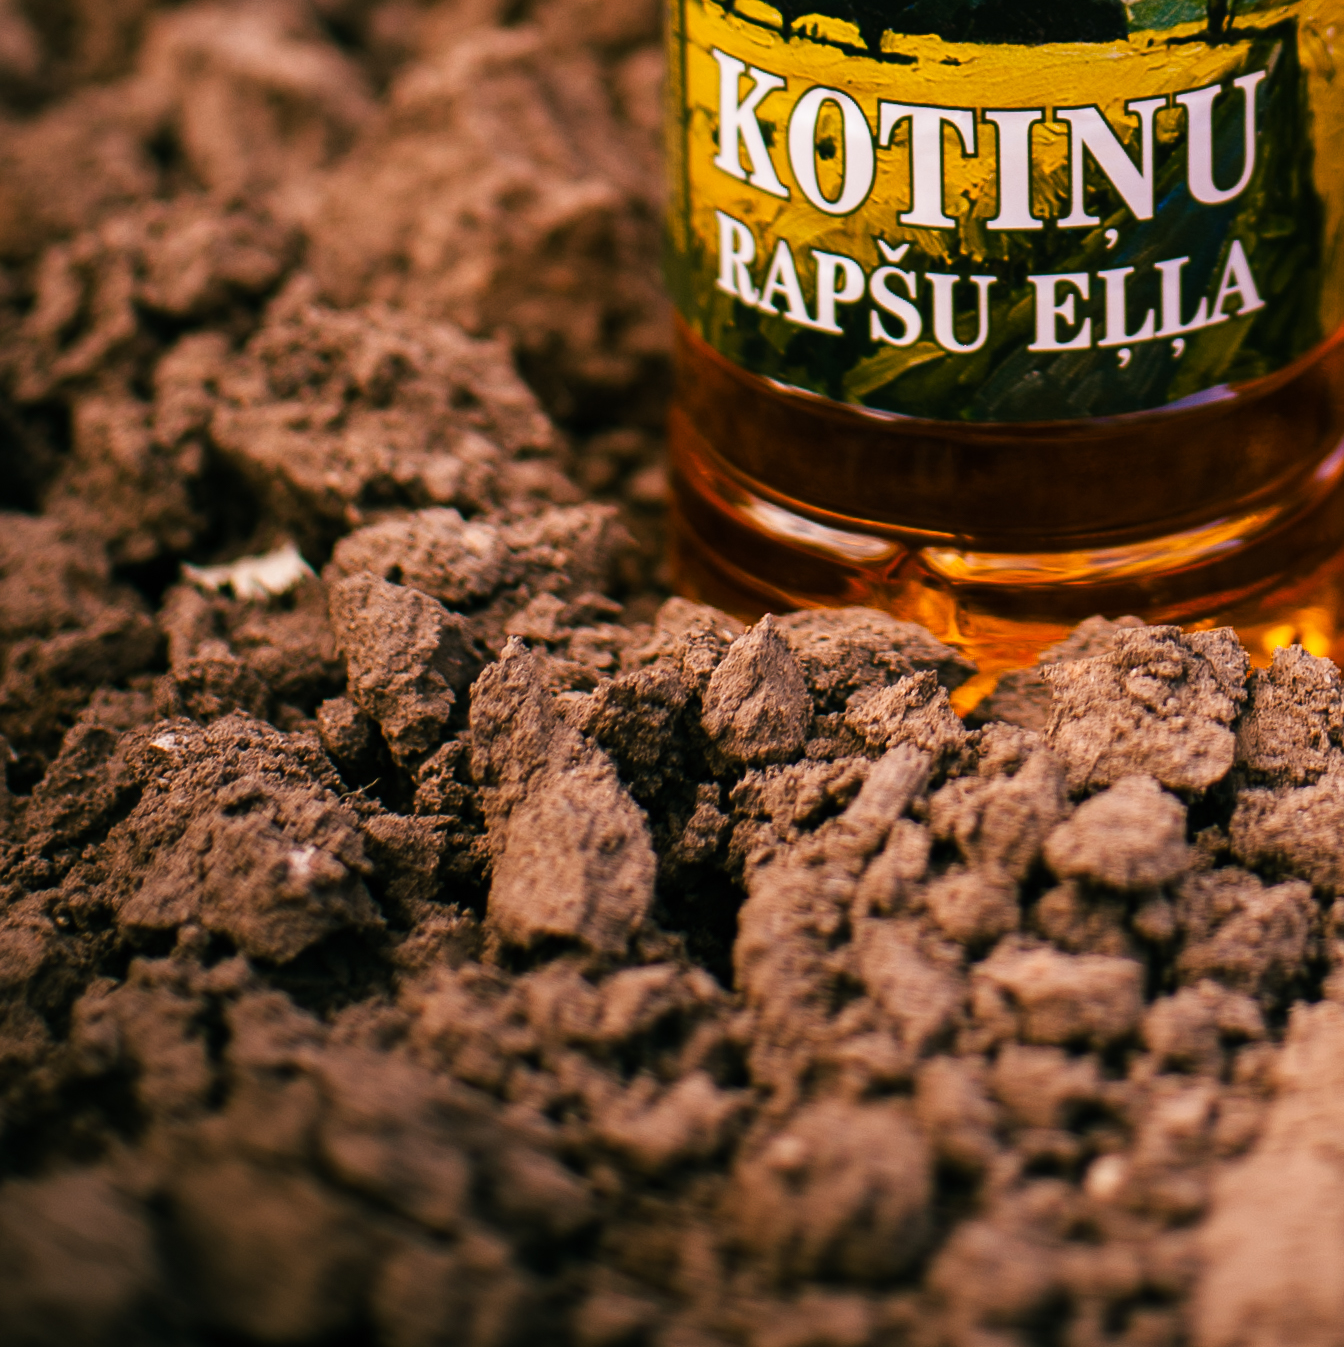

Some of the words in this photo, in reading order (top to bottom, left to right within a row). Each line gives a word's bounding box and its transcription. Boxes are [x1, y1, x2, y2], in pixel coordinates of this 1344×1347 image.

[712, 48, 1267, 250] KOTIŅU
[714, 210, 998, 354] RAPŠU
[1026, 239, 1266, 369] EĻĻA
